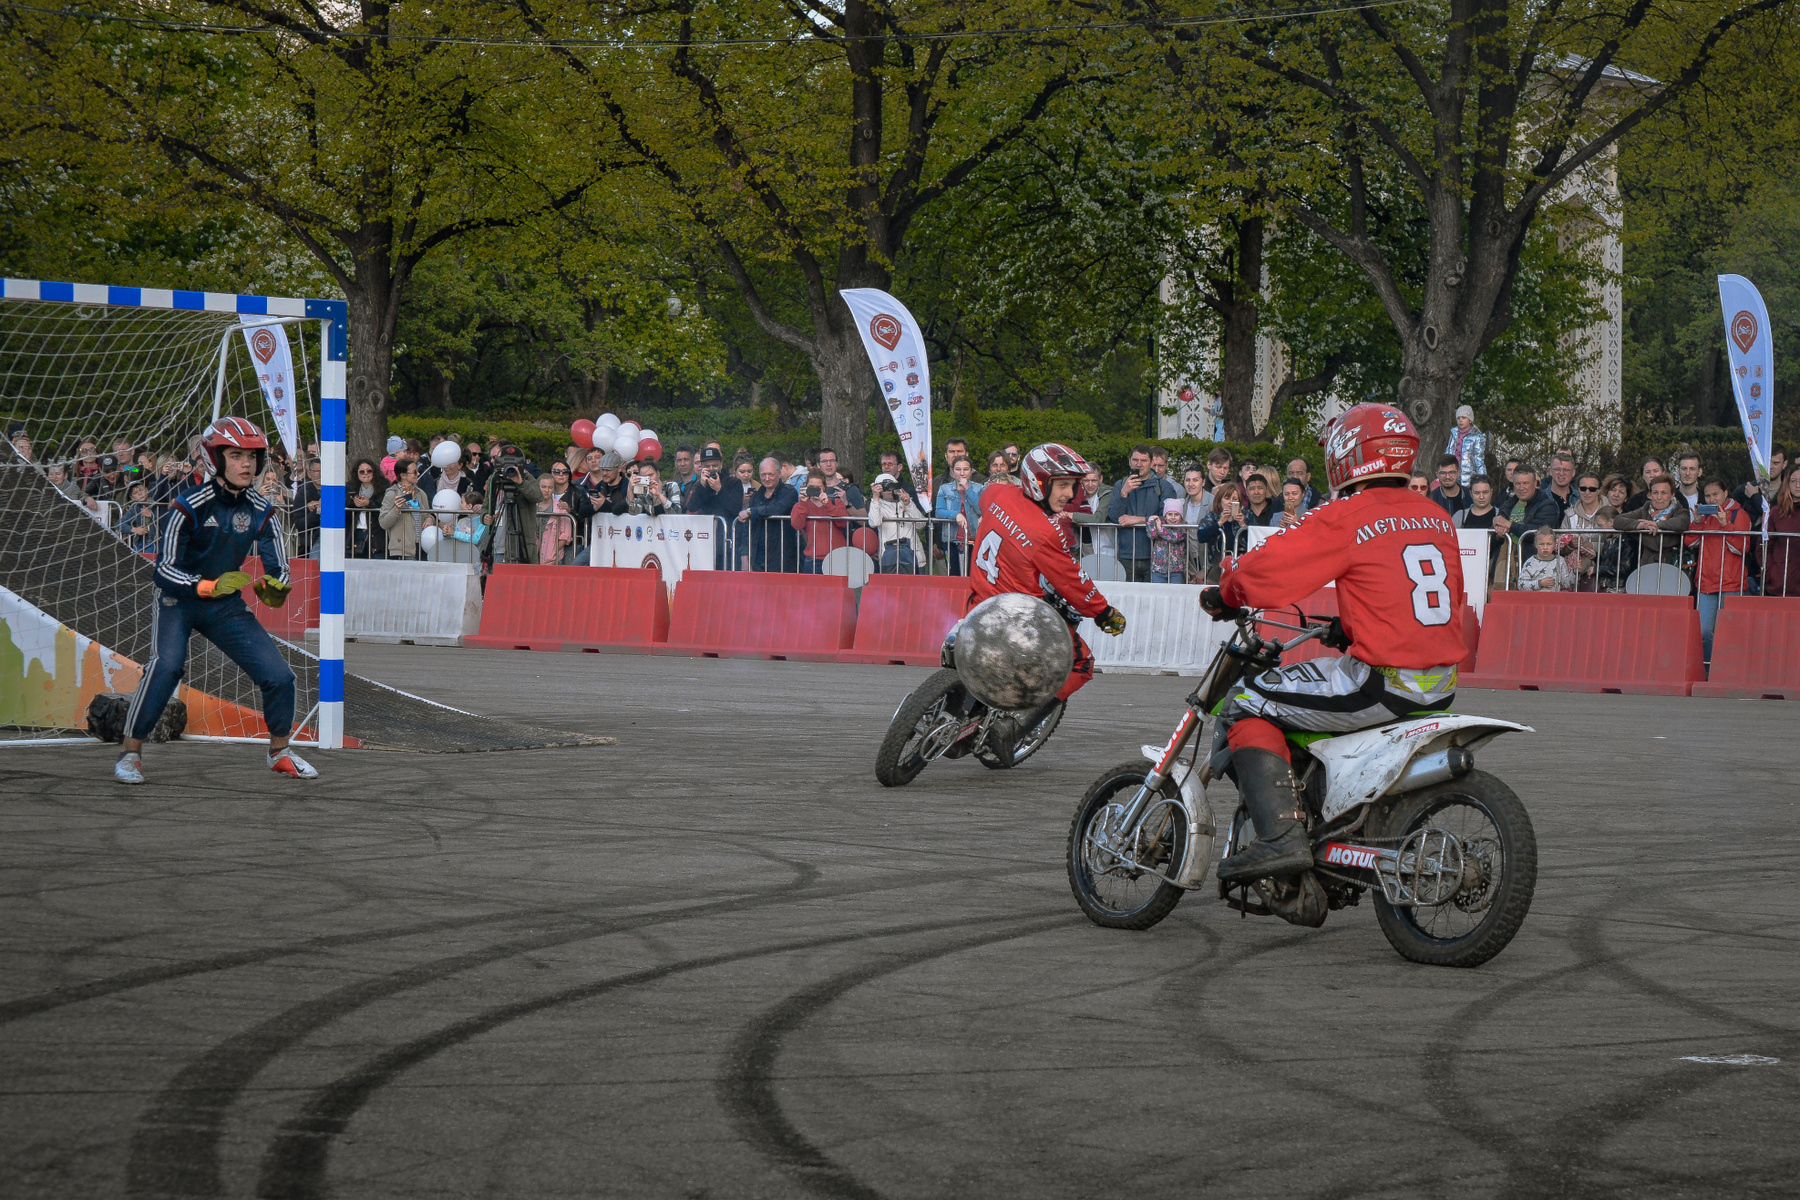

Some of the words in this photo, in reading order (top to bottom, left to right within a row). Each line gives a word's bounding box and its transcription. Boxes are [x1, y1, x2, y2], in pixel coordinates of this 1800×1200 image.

[1352, 460, 1386, 477] MOTUL
[988, 502, 1033, 548] ЕТАЛЛУРГ
[974, 529, 1003, 585] 4
[1402, 542, 1451, 627] 8
[1406, 724, 1438, 738] MOTUL
